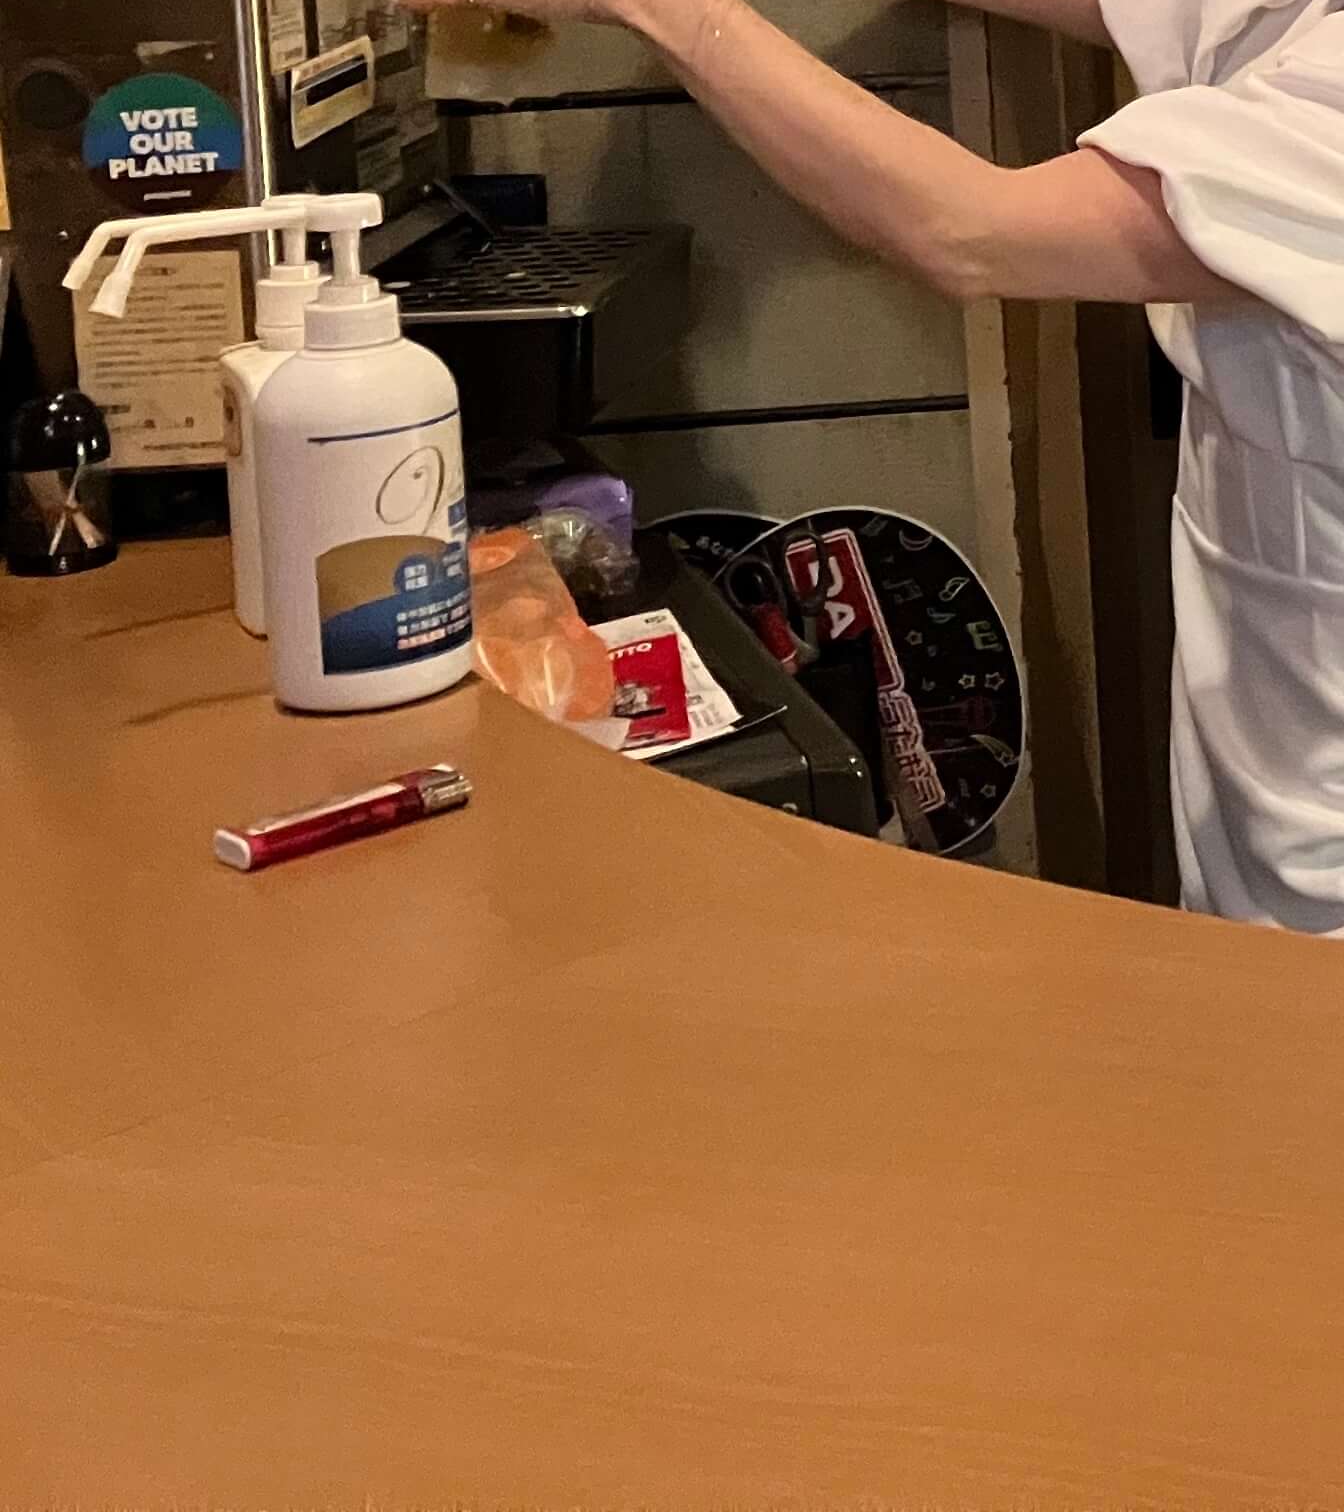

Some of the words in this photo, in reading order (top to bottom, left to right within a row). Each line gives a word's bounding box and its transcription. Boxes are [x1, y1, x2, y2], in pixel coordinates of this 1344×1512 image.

[120, 106, 198, 133] VOTE
[130, 131, 194, 154] OUR
[109, 151, 218, 179] PLANET
